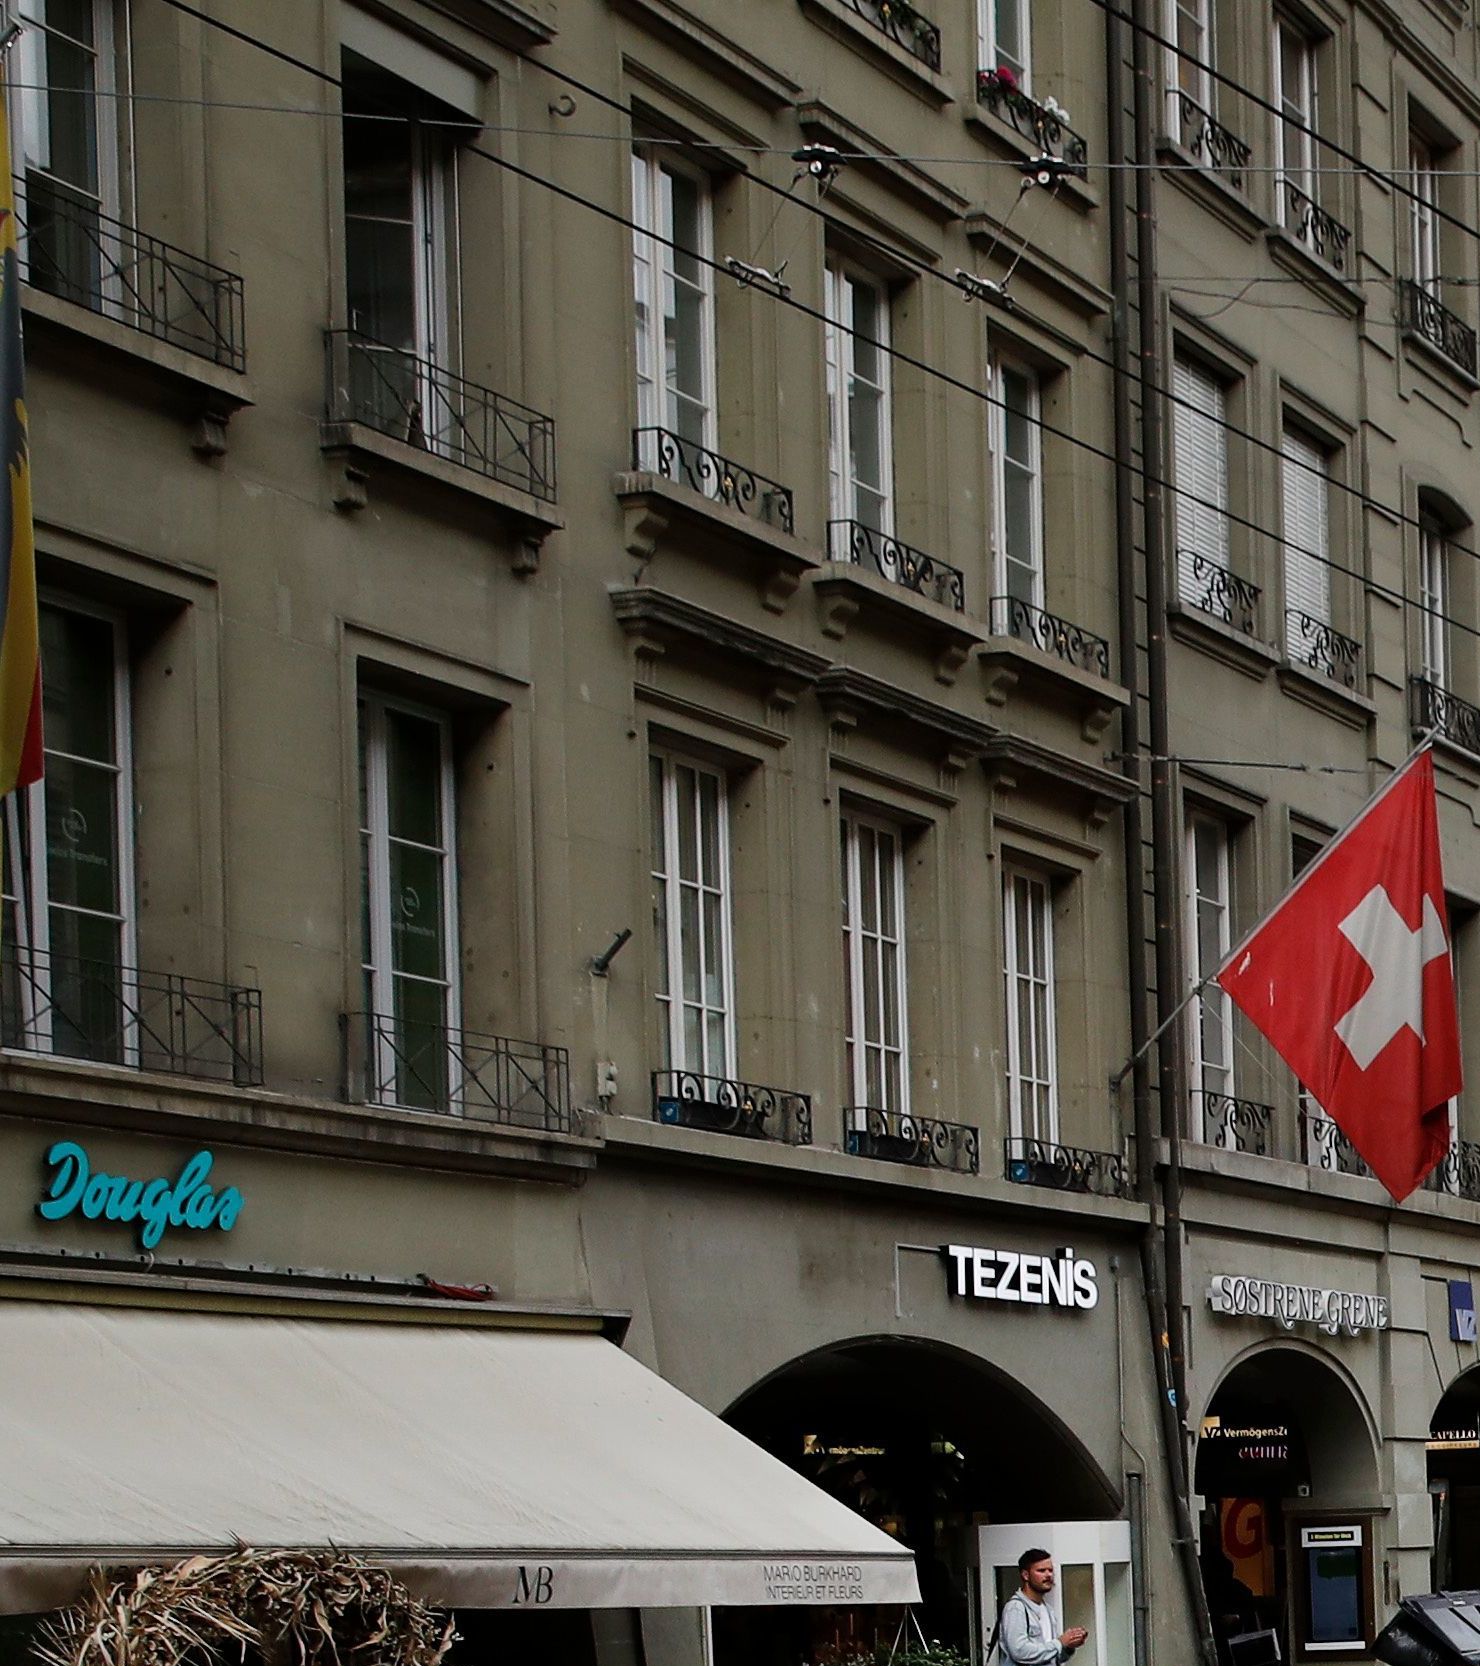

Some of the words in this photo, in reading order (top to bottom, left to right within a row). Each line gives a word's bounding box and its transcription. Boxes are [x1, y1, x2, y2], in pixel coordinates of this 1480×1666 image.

[39, 1140, 246, 1249] Douglas
[1217, 1276, 1322, 1331] SØSTRENE
[1319, 1290, 1388, 1336] GRENE
[512, 1565, 554, 1604] MB
[763, 1565, 802, 1582] MARIO
[804, 1565, 862, 1582] BURKHARD
[816, 1585, 826, 1599] ET
[828, 1585, 864, 1599] FLEURS
